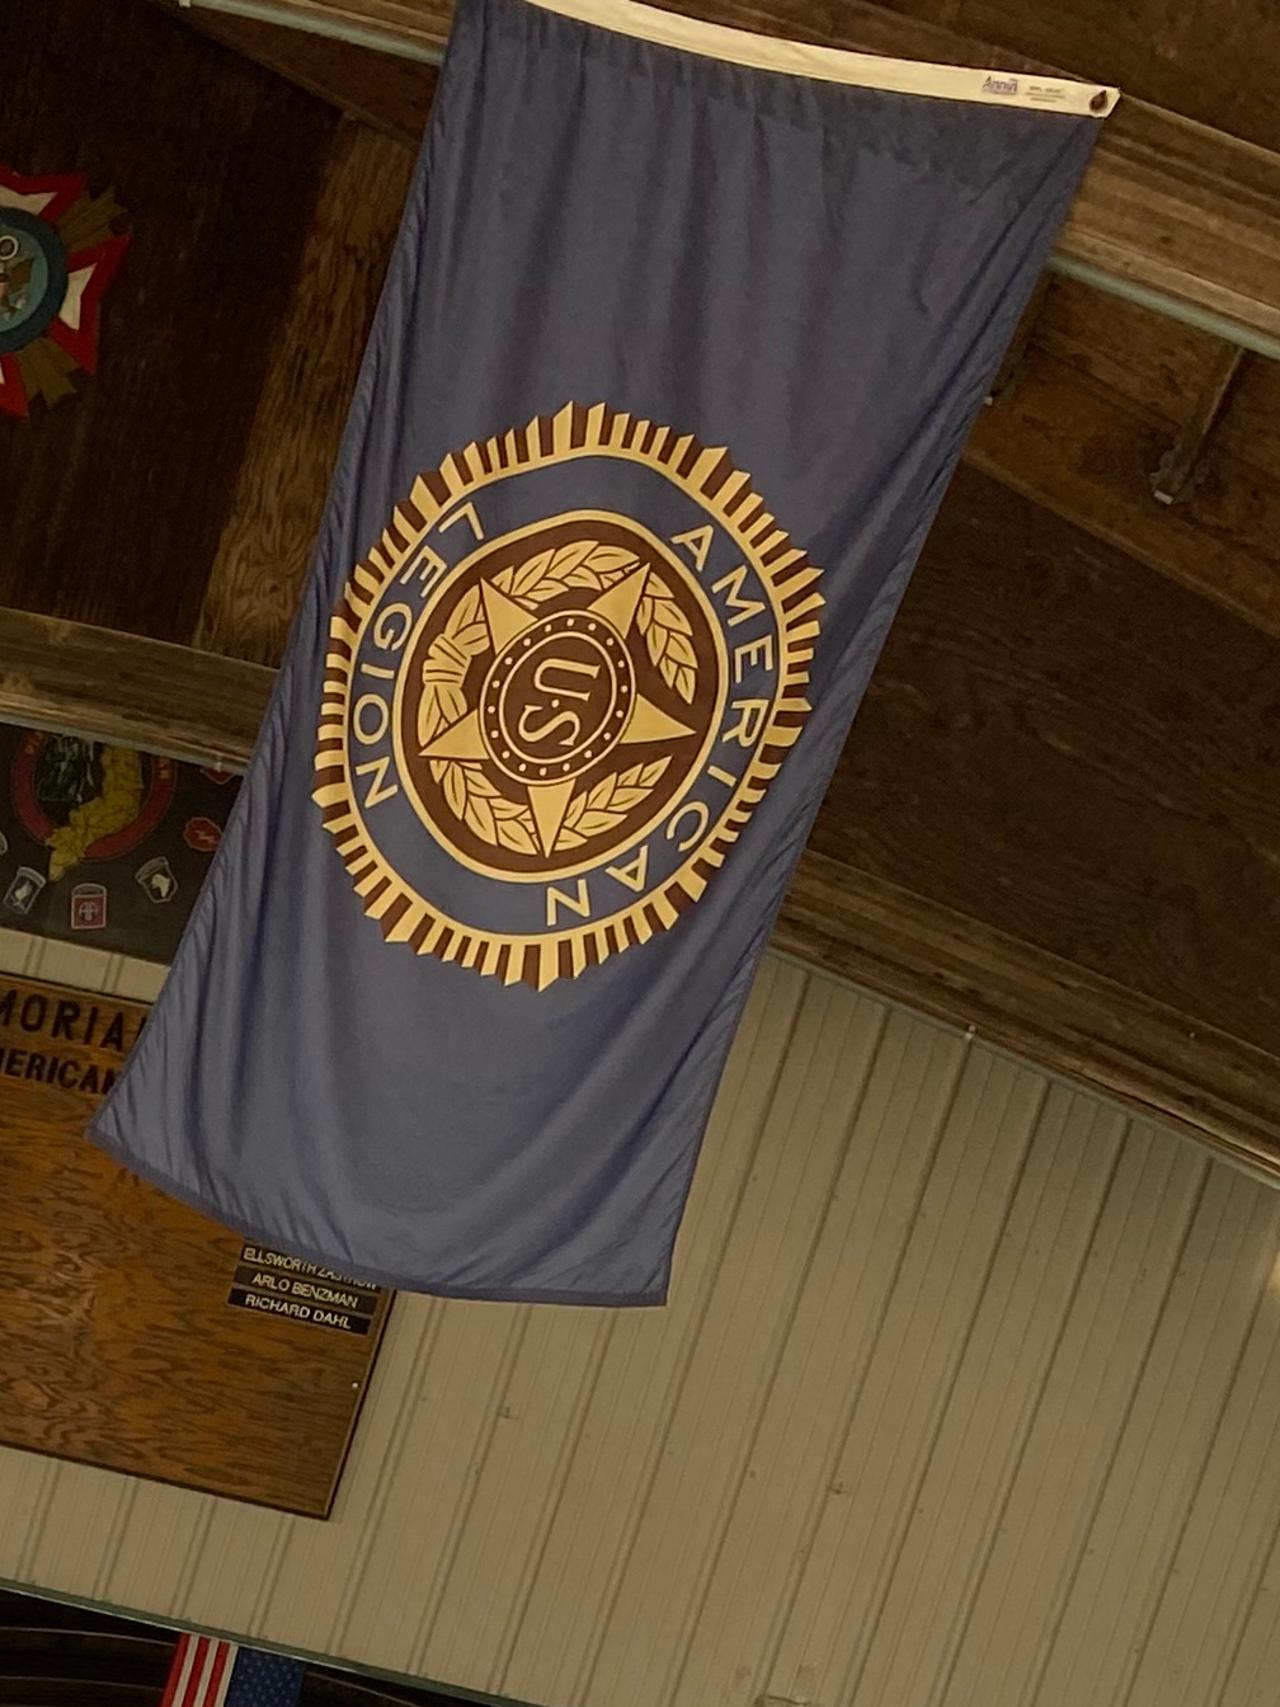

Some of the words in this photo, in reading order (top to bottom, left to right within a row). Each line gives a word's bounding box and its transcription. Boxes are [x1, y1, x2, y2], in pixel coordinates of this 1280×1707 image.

[352, 501, 485, 809] LEGION
[546, 522, 775, 928] AMERICAN
[245, 1294, 311, 1318] RICHARD
[313, 1310, 352, 1330] DAHL
[252, 1273, 290, 1292] ARLO
[292, 1282, 359, 1309] BENZMAN
